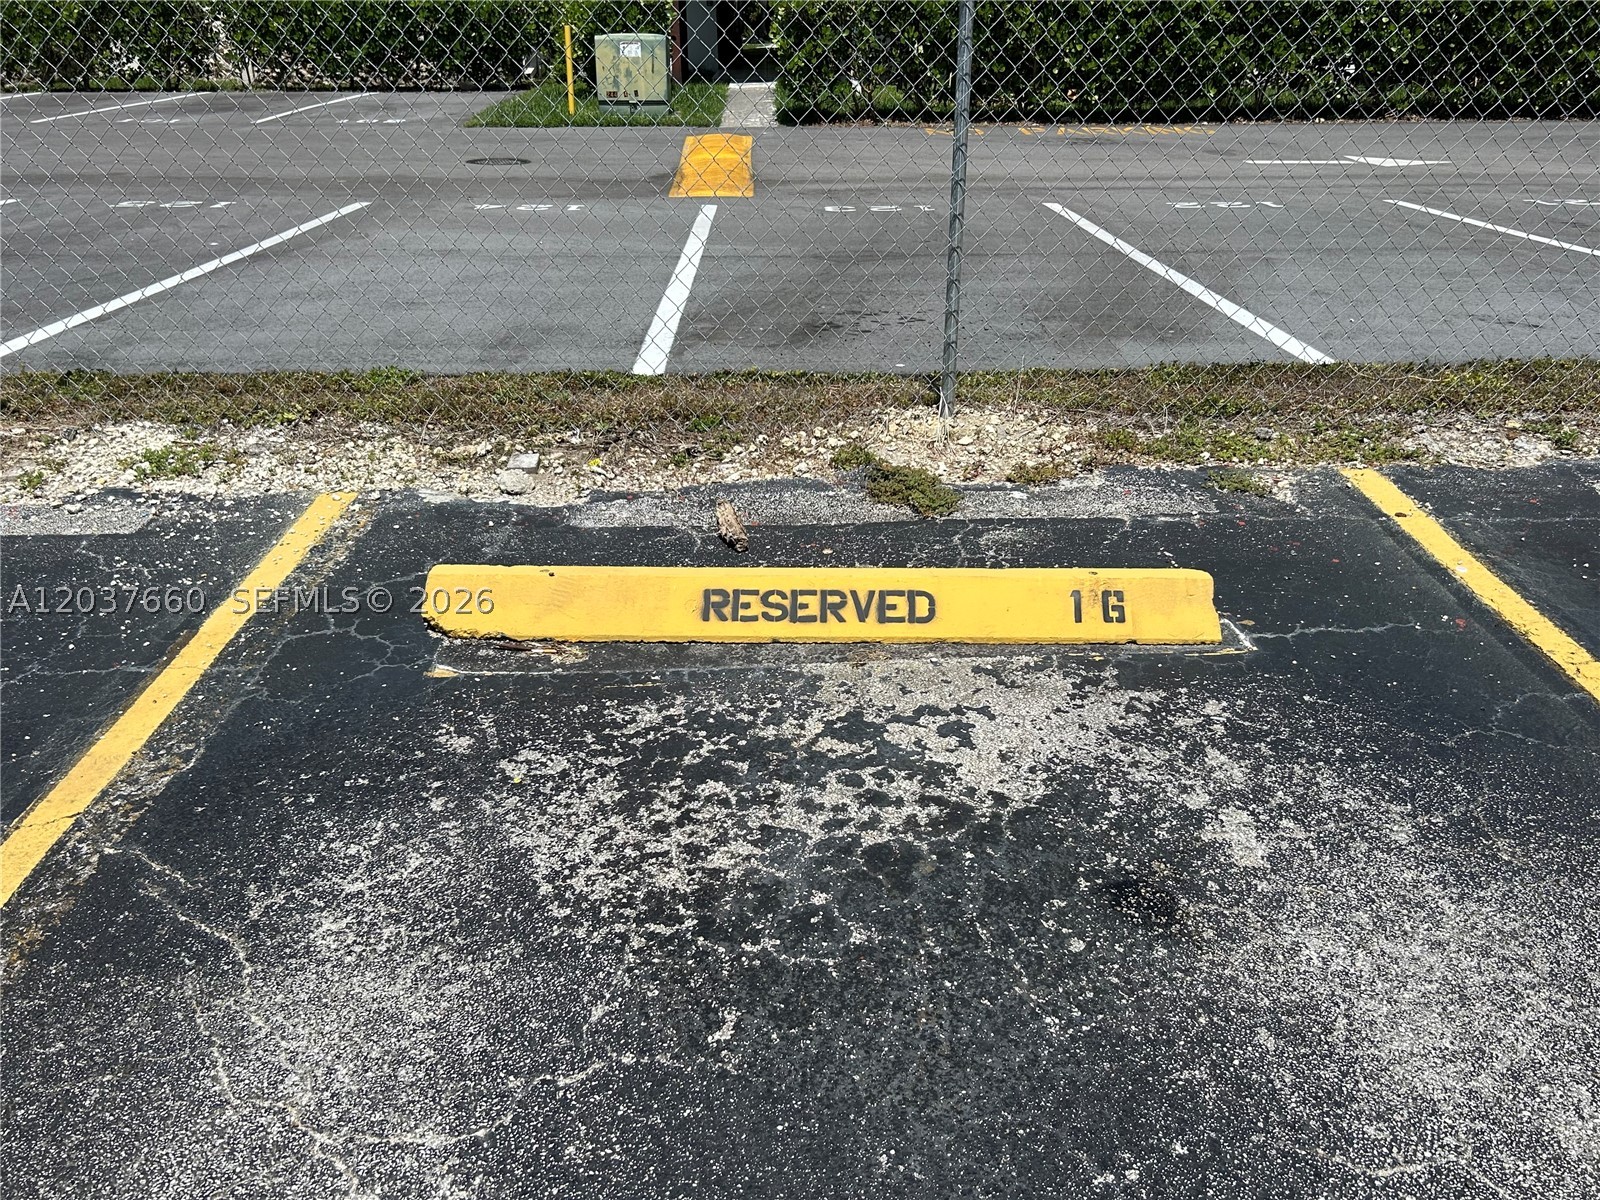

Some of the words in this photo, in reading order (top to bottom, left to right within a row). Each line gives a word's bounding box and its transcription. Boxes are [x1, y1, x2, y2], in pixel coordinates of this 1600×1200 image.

[1018, 126, 1216, 136] PARKING
[474, 203, 587, 211] 124
[701, 588, 937, 624] RESERVED
